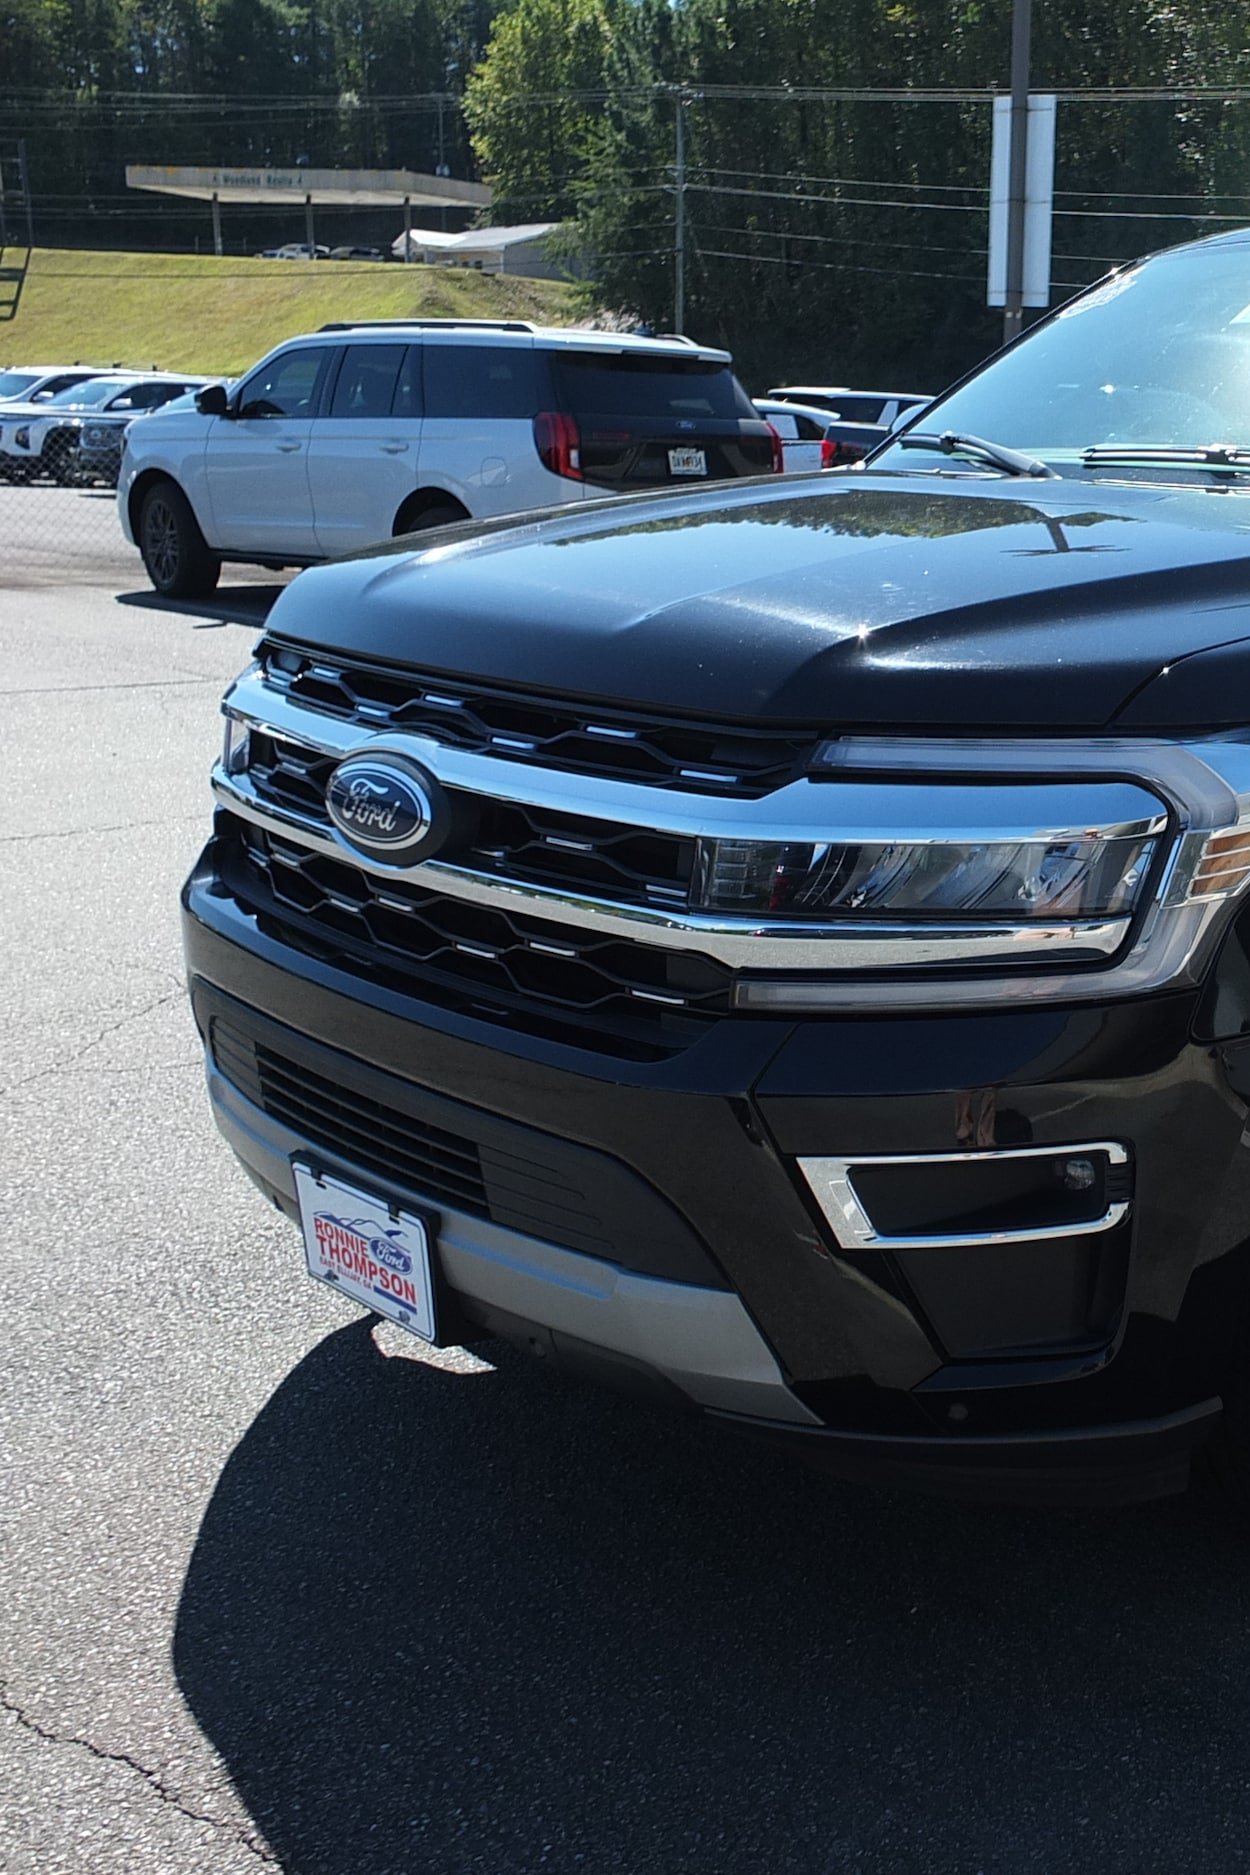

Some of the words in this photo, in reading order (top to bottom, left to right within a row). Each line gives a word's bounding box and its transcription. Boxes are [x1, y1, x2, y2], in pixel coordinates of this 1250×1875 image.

[342, 778, 401, 831] Ford
[313, 1217, 370, 1259] RONNIE
[376, 1241, 405, 1272] Ford
[316, 1234, 417, 1305] THOMPSON
